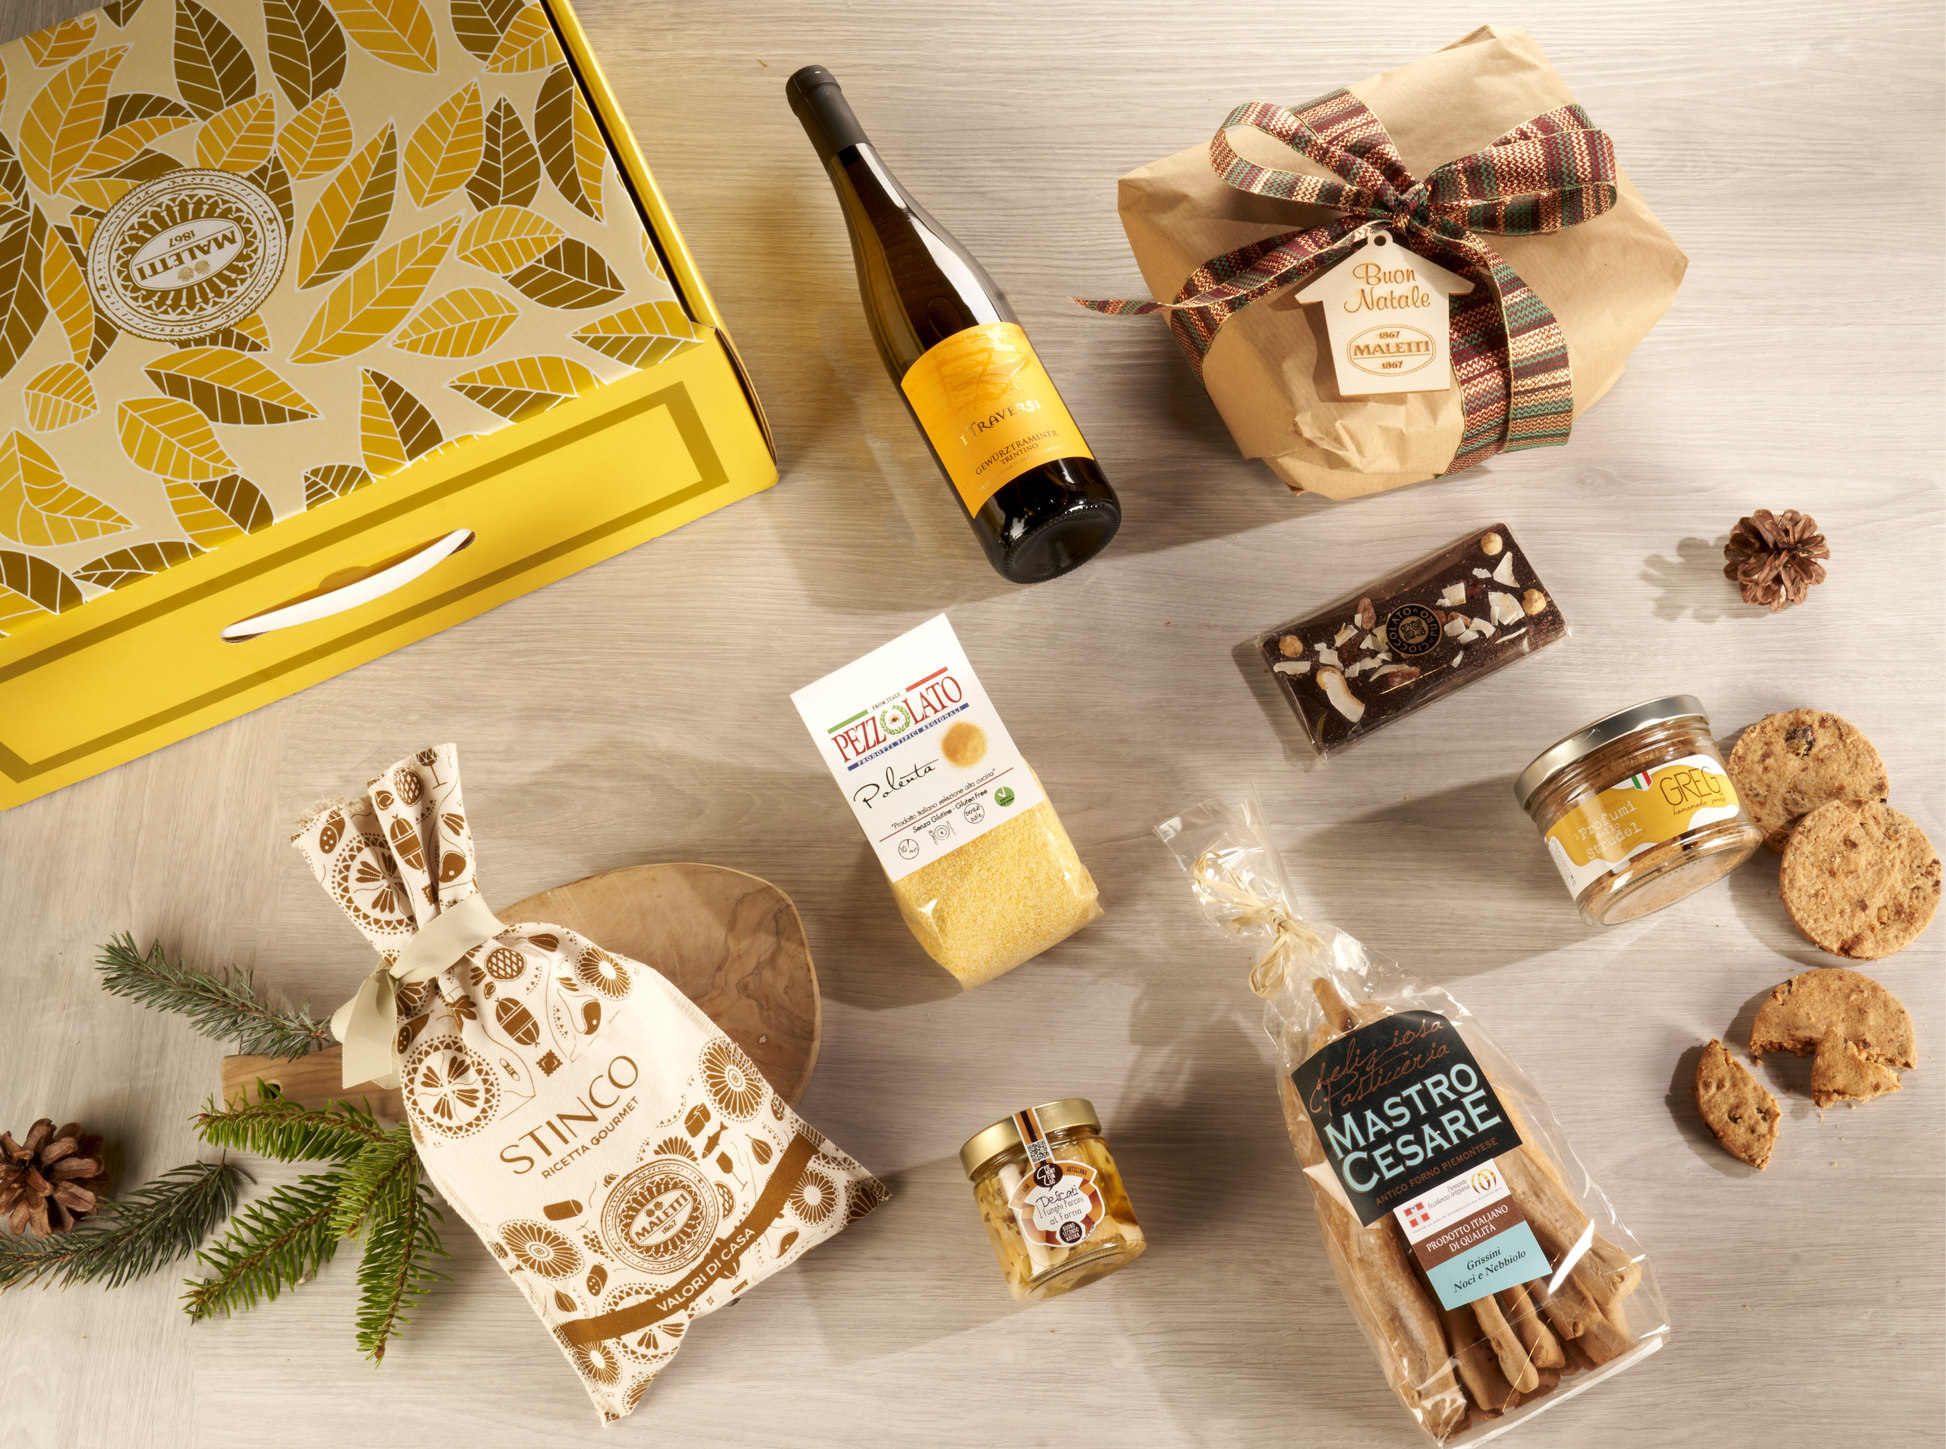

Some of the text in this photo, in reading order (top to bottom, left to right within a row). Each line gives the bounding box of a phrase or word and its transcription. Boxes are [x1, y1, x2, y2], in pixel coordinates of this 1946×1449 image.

[136, 230, 237, 282] MALETTI
[169, 230, 195, 248] 1867
[1352, 262, 1416, 286] Buon
[1344, 286, 1430, 313] Natale
[1353, 341, 1430, 357] MALETTI
[1379, 331, 1400, 339] 1867
[1382, 361, 1403, 369] 1867
[960, 400, 1042, 446] I TRAVERSI
[975, 430, 1060, 475] GEWÜRZTRAMINER
[1000, 443, 1038, 465] TRENTINO
[1389, 608, 1430, 653] CIOCCOLATO
[872, 692, 901, 711] FROM ITALY
[857, 707, 961, 767] PRODOTTI TIPICI REGIONALI
[853, 759, 939, 808] Polenta
[939, 790, 964, 805] selezione
[1660, 766, 1720, 806] GREG
[913, 821, 931, 834] Senza
[931, 809, 952, 823] Glutine
[955, 796, 975, 810] Gluten
[974, 789, 988, 799] Free
[1578, 800, 1637, 840] Profumi
[1586, 822, 1642, 860] Strudel
[500, 1055, 638, 1175] STINCO
[1324, 1063, 1478, 1160] MASTRO
[541, 1096, 639, 1179] RICETTA GOURMET
[1342, 1088, 1502, 1192] CESARE
[1375, 1137, 1498, 1206] ANTICO FORNO PIEMONTESE
[1035, 1184, 1079, 1208] Delicati
[1042, 1204, 1063, 1216] Funghi
[1060, 1208, 1082, 1220] Forno
[635, 1193, 689, 1241] MALETTI
[661, 1219, 677, 1235] 1867
[1426, 1204, 1509, 1252] PRODOTTO ITALIANO
[1449, 1222, 1497, 1252] DI QUALITÀ
[656, 1228, 755, 1311] VALORI DI CASA
[1454, 1274, 1476, 1293] Noci
[1485, 1250, 1526, 1276] Nebbiolo
[1466, 1247, 1501, 1271] Grissini
